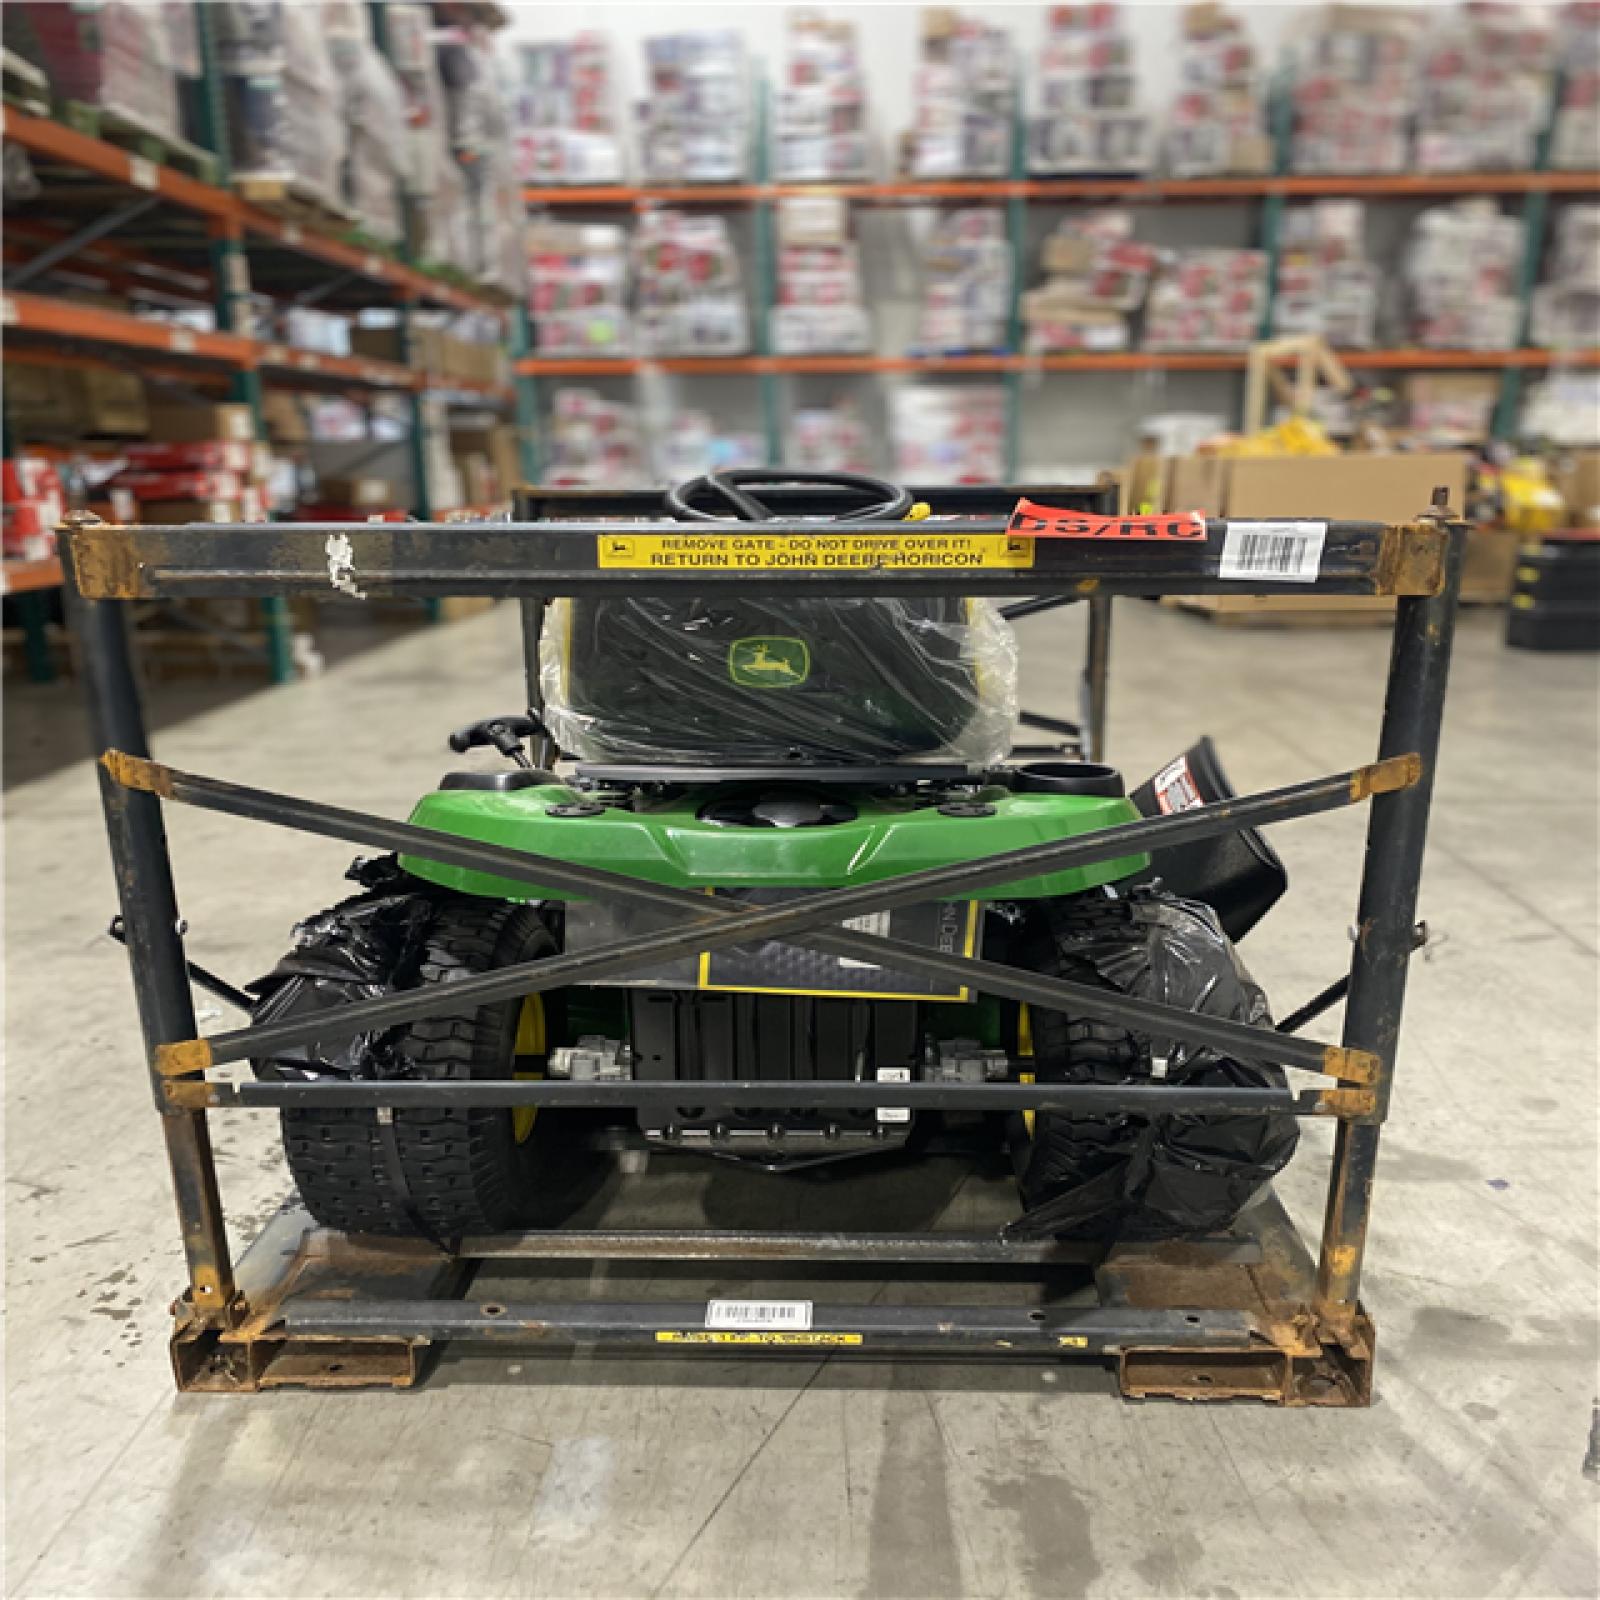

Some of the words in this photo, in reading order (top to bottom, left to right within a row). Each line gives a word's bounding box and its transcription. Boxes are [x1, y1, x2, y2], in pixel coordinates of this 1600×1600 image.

[662, 539, 729, 550] REMOVE
[732, 539, 775, 550] GATE
[789, 539, 811, 550] DO
[816, 539, 848, 550] NOT
[852, 539, 899, 550] DRIVE
[904, 539, 948, 550] OVER
[953, 539, 971, 550] IT!
[652, 554, 729, 566] RETURN
[735, 554, 760, 566] TO
[765, 554, 818, 566] JOHN
